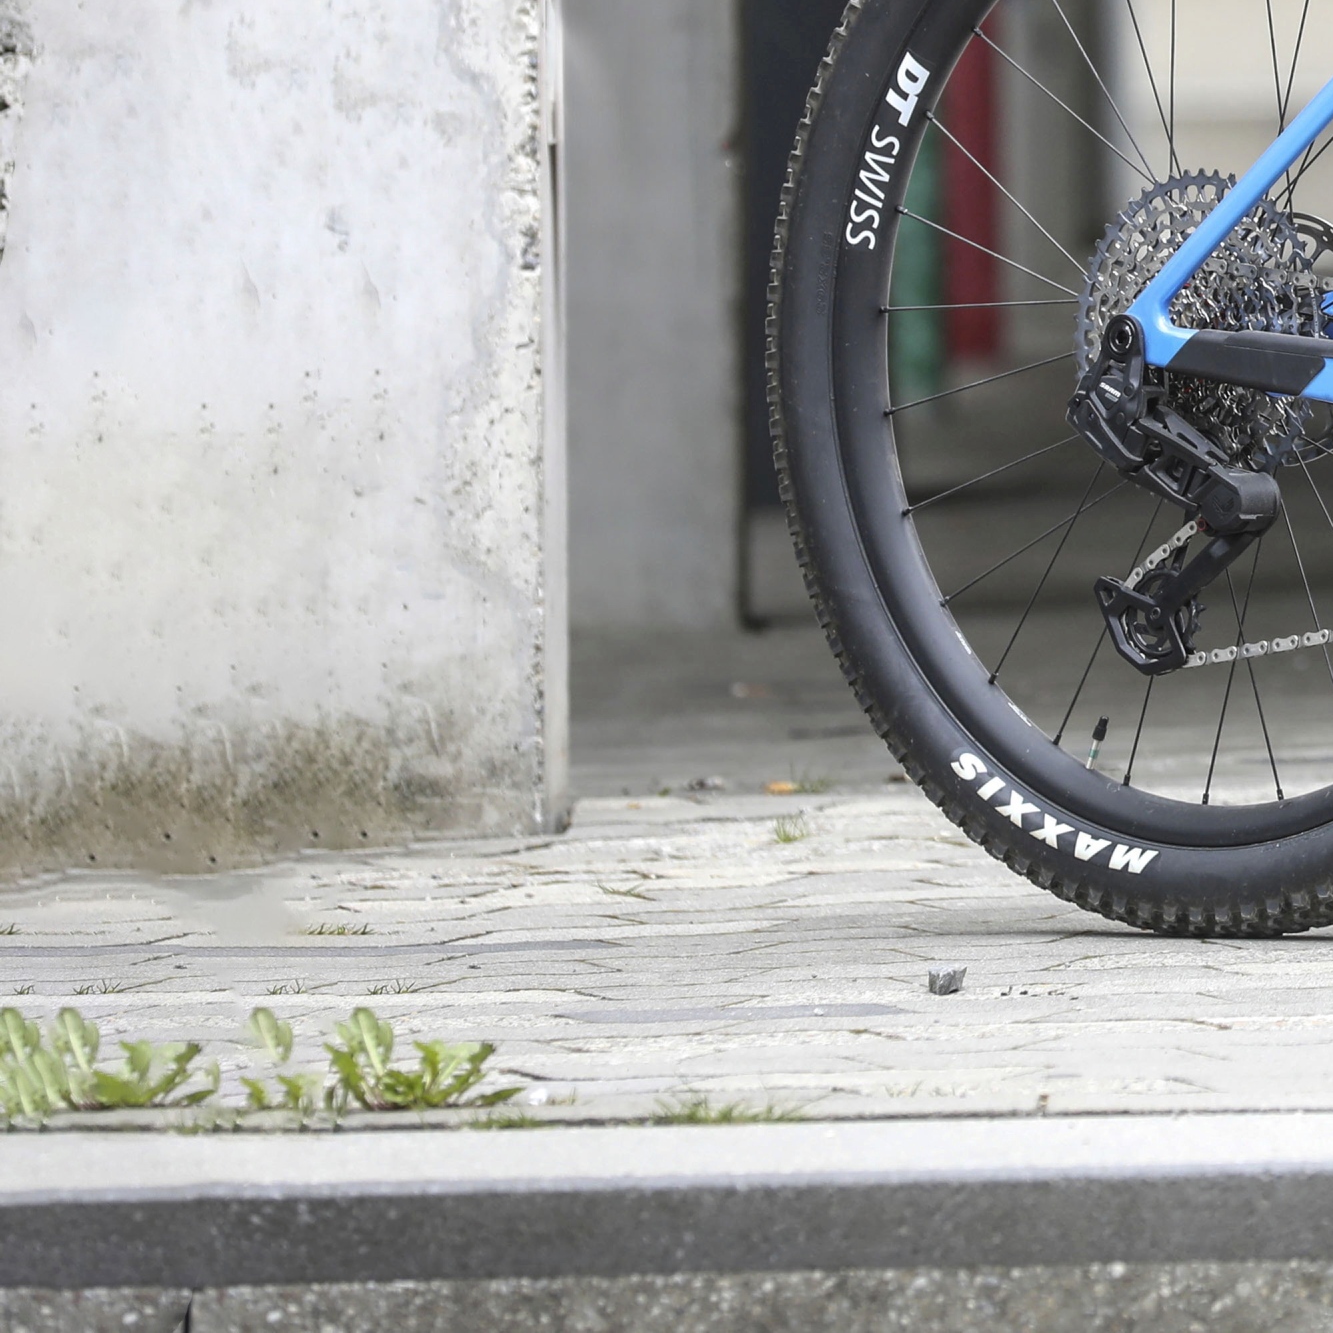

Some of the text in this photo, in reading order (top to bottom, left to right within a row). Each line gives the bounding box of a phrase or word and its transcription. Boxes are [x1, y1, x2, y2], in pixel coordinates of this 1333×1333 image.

[845, 51, 930, 250] DT SWISS
[1099, 381, 1122, 398] SRAM
[951, 752, 1159, 874] MAXXIS
